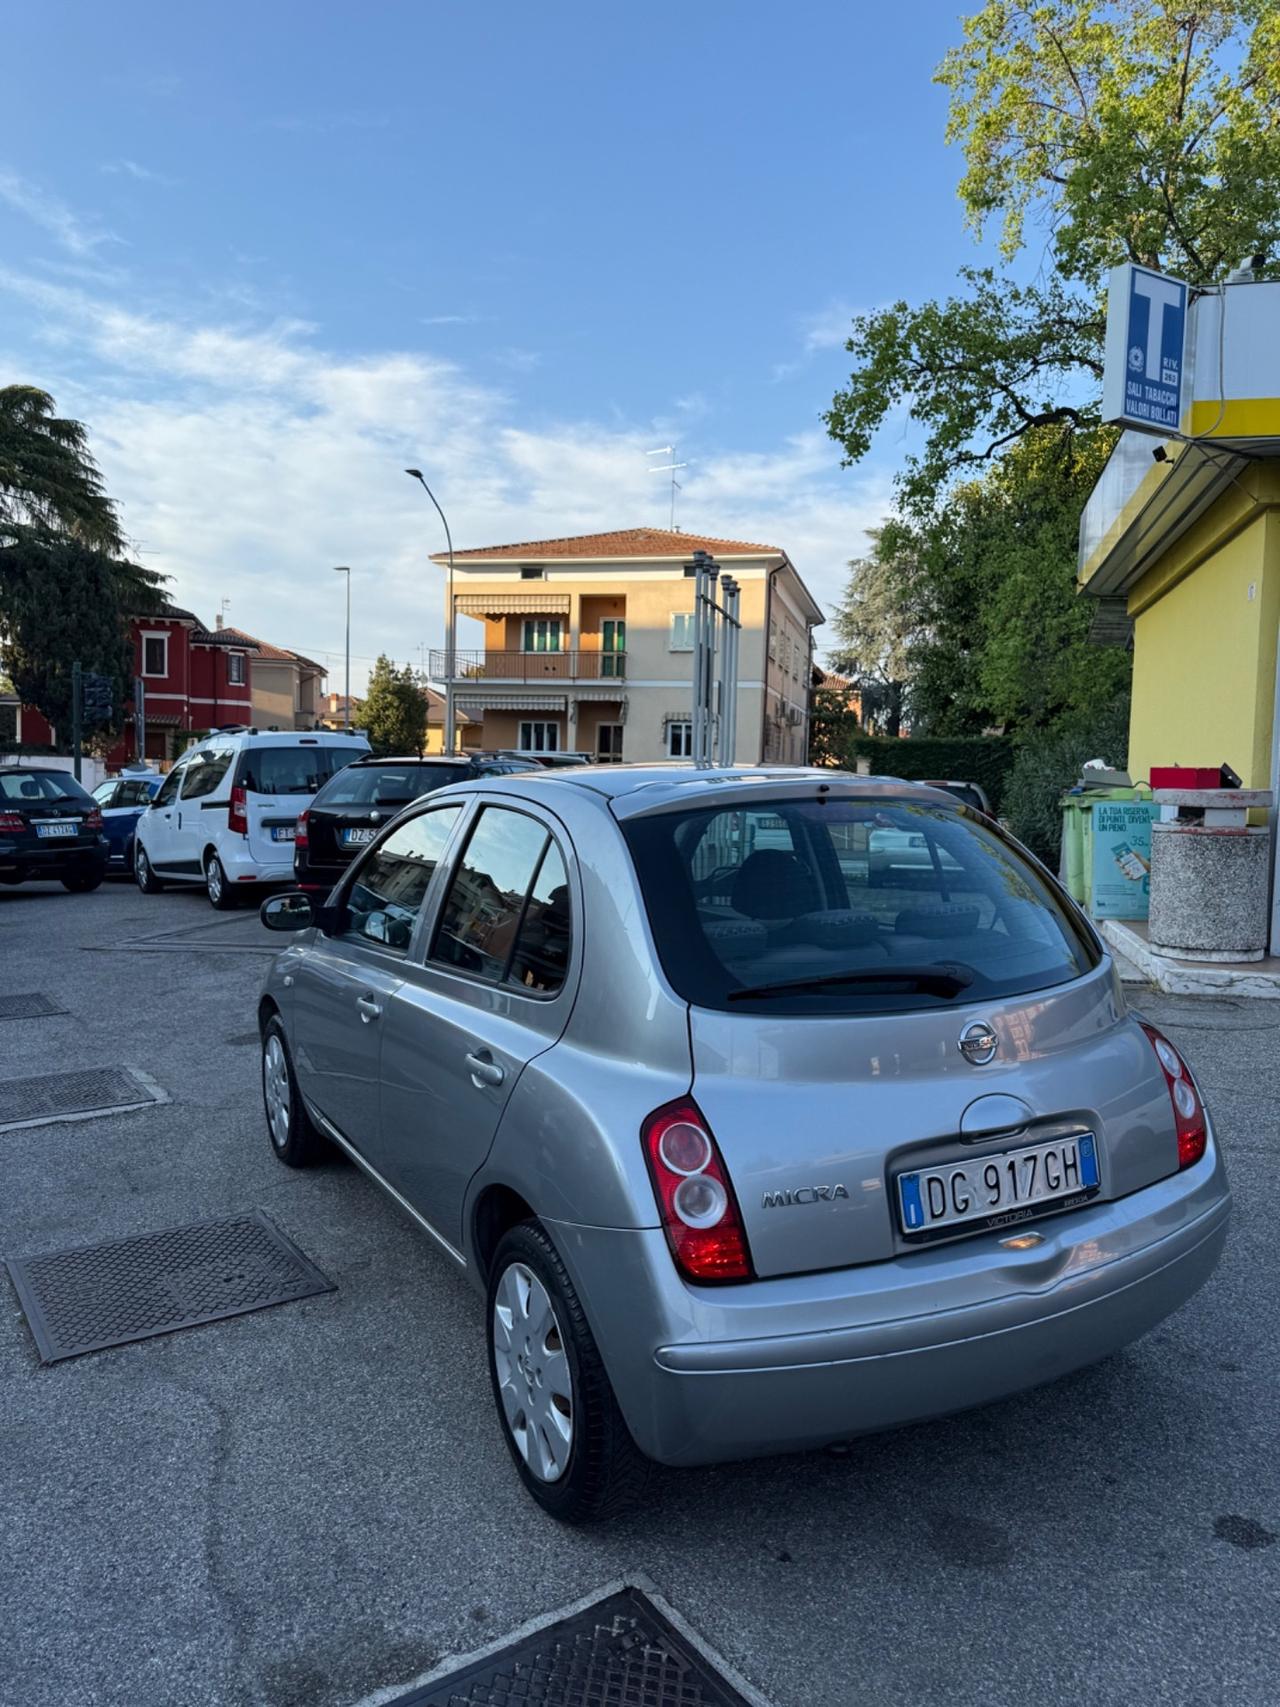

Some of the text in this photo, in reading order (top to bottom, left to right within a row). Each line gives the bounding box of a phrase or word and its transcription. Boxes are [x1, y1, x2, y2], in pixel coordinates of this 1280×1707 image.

[1134, 270, 1181, 382] T
[1163, 357, 1178, 370] RIV.
[1127, 381, 1177, 406] SALI TABACCHI
[1126, 398, 1177, 425] VALORI BOLLATI
[351, 829, 365, 841] DZ
[925, 1144, 1079, 1220] DG 917GH
[761, 1183, 850, 1209] MICRA
[986, 1208, 1034, 1227] VICTORIA
